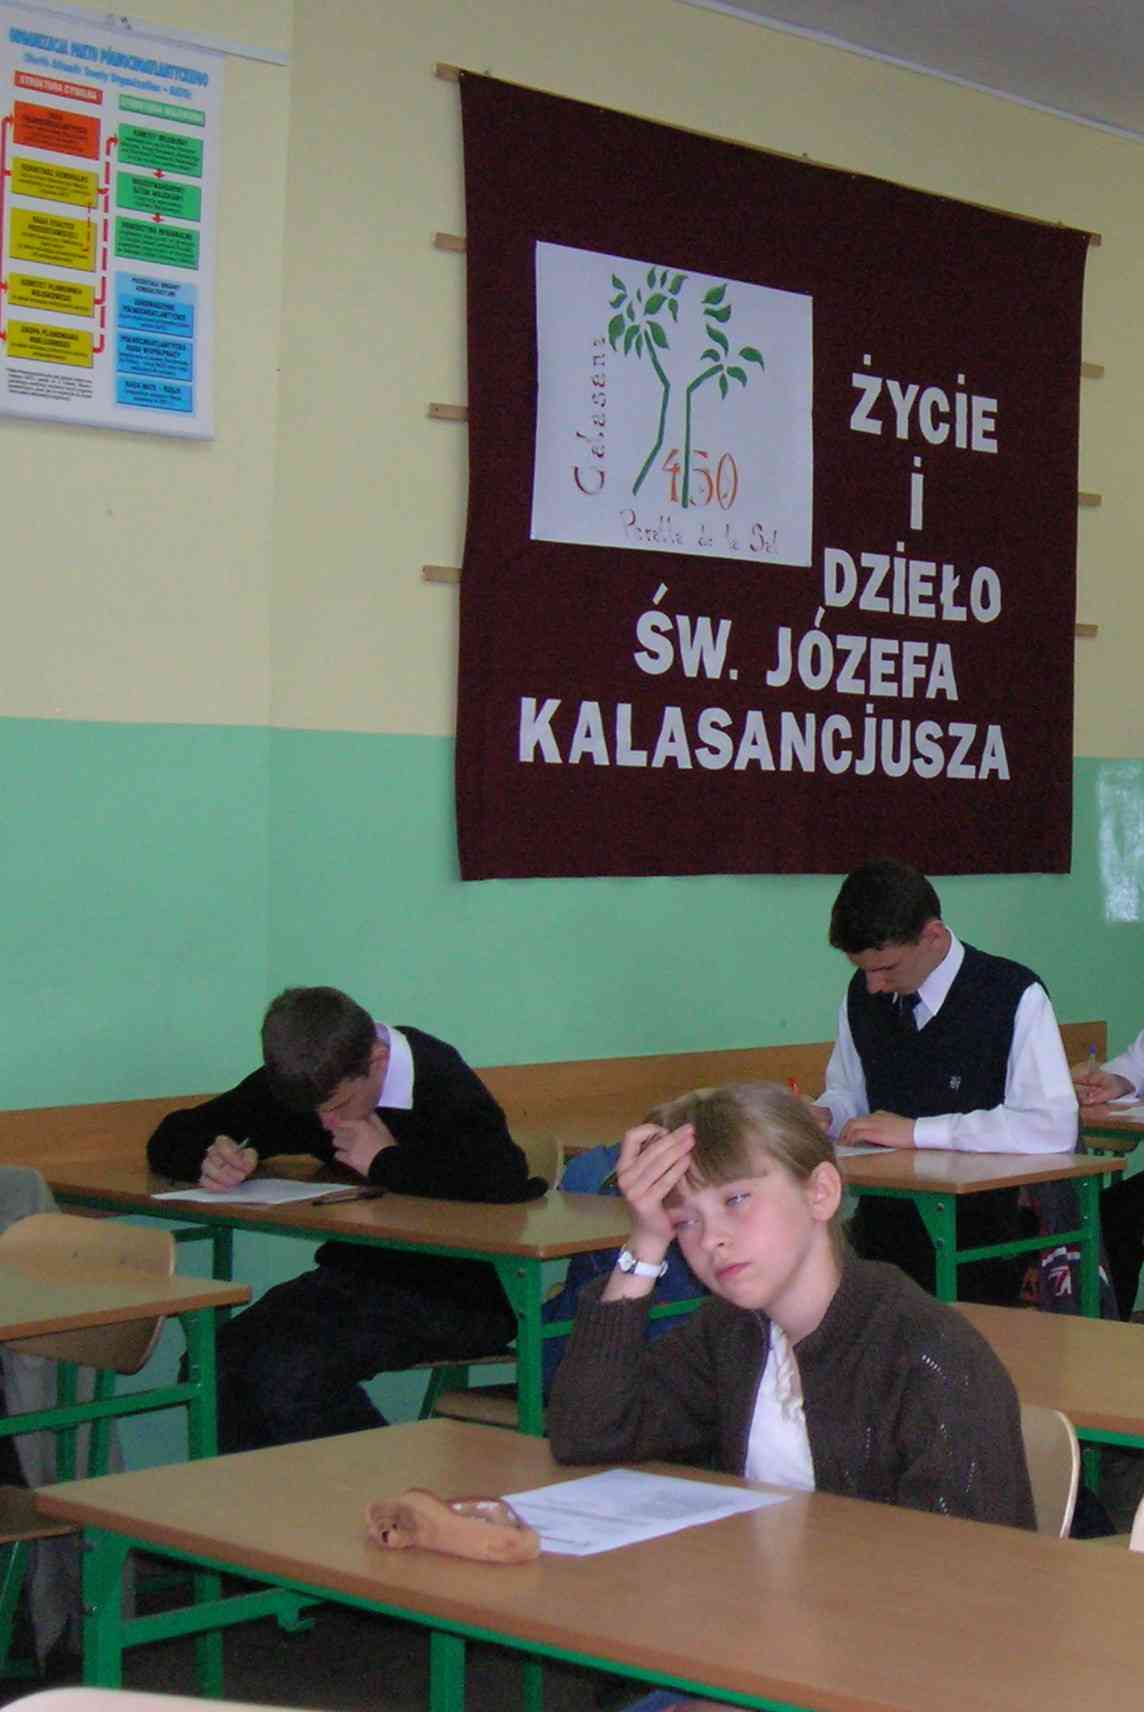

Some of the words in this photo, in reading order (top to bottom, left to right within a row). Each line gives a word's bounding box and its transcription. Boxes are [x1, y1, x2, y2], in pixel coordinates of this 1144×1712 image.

[661, 447, 738, 511] 450
[634, 582, 739, 681] ŚW.
[766, 605, 959, 701] JÓZEFA
